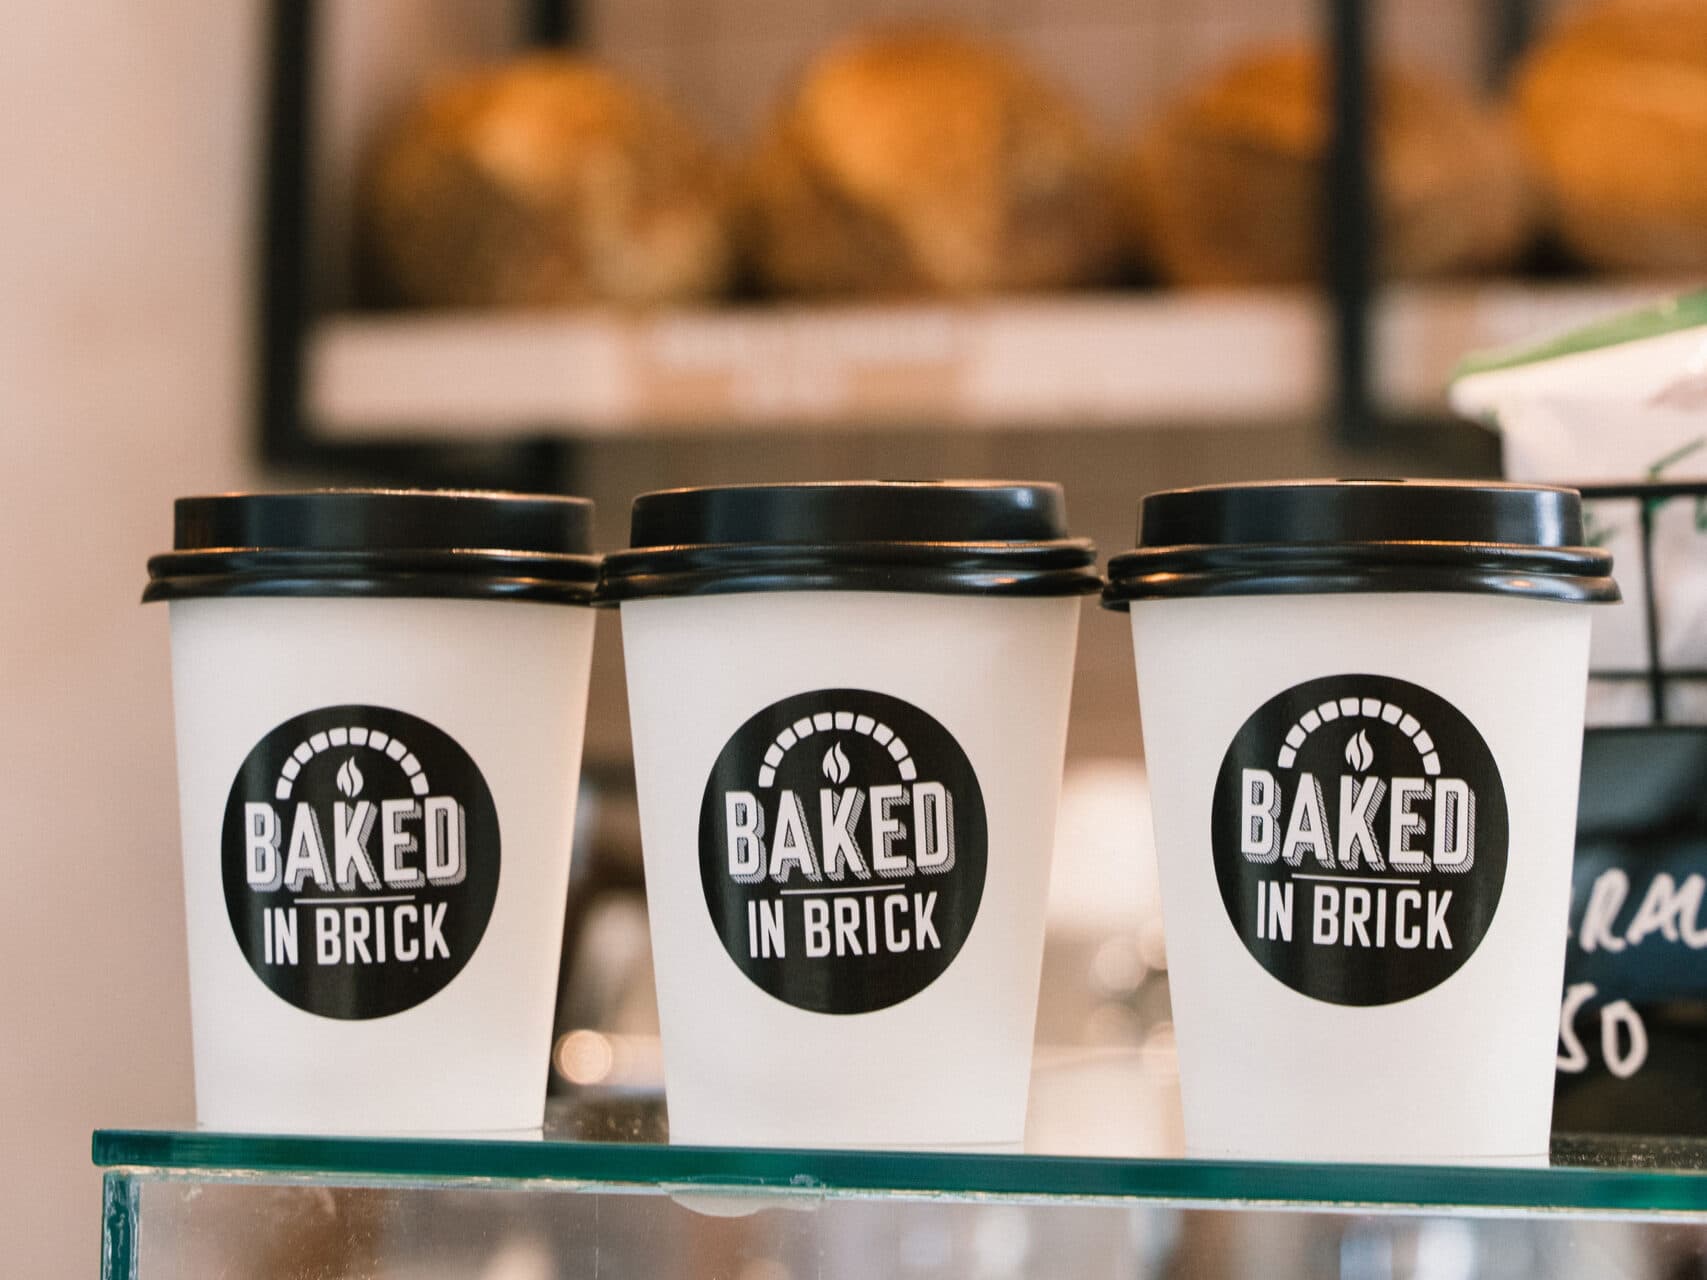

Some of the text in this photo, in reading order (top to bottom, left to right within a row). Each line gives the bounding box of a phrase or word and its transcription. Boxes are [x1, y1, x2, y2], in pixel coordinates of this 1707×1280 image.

[244, 796, 467, 892] BAKED
[725, 781, 955, 884] BAKED
[1240, 768, 1476, 873] BAKED
[263, 902, 450, 966] IN BRICK
[748, 891, 941, 959] IN BRICK
[1256, 880, 1454, 950] IN BRICK
